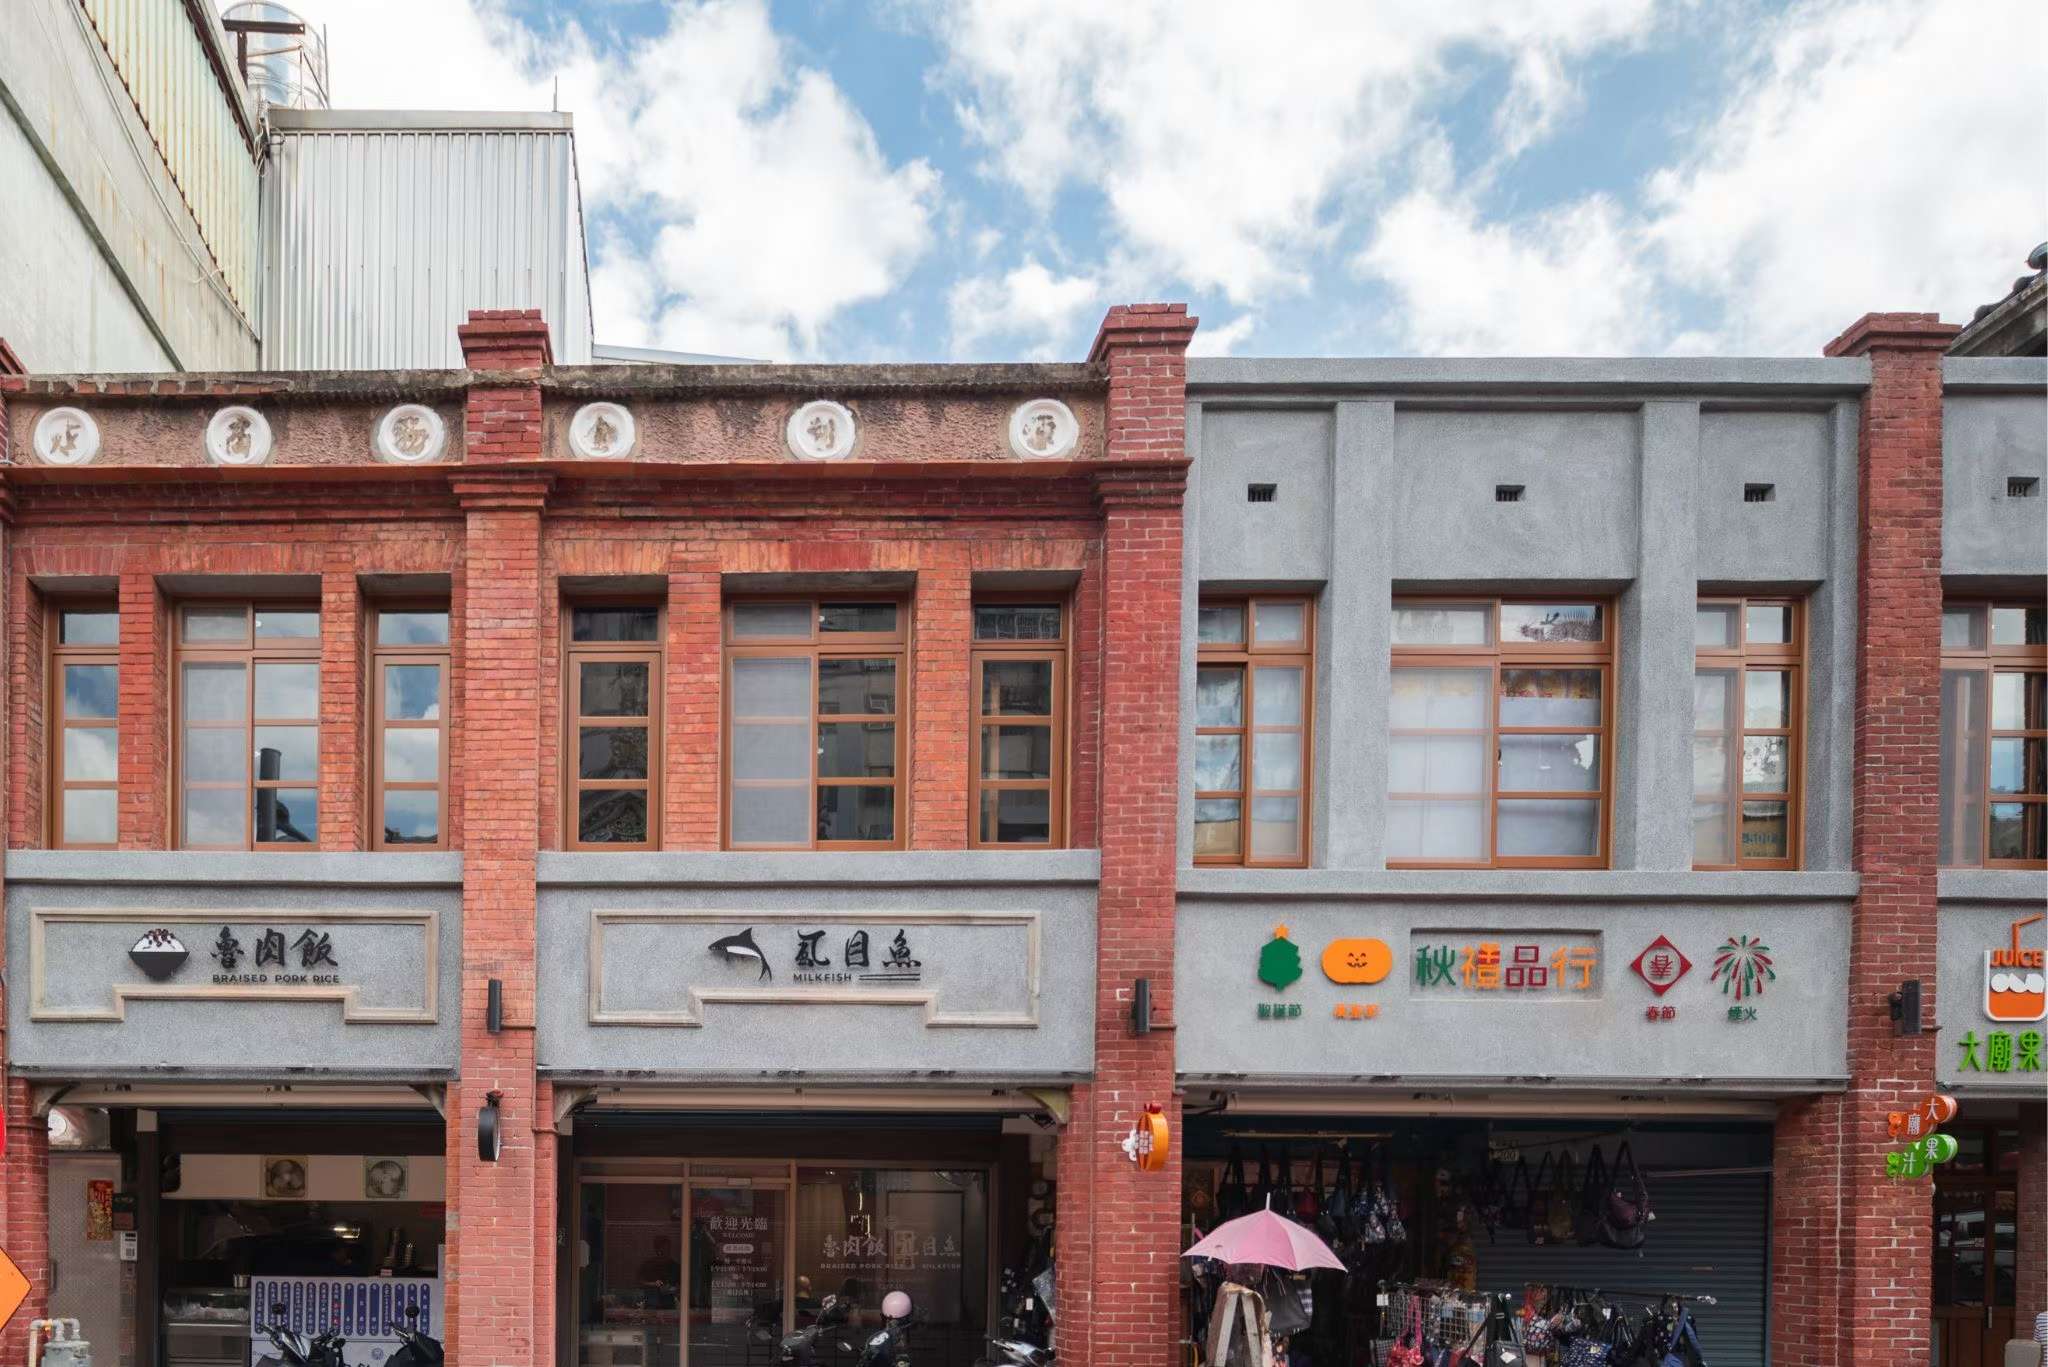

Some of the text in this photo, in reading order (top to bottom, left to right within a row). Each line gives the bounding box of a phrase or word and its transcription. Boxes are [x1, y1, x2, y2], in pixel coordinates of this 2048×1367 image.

[210, 925, 338, 969] 魯肉飯
[795, 929, 922, 967] 虱目魚
[1989, 949, 2044, 968] JUICE
[212, 974, 341, 984] BRAISED PORK RICE
[793, 973, 852, 982] MILKFISH
[1646, 1006, 1676, 1022] 春節
[1727, 1006, 1758, 1022] 煙火
[1958, 1029, 2044, 1073] 大廟果
